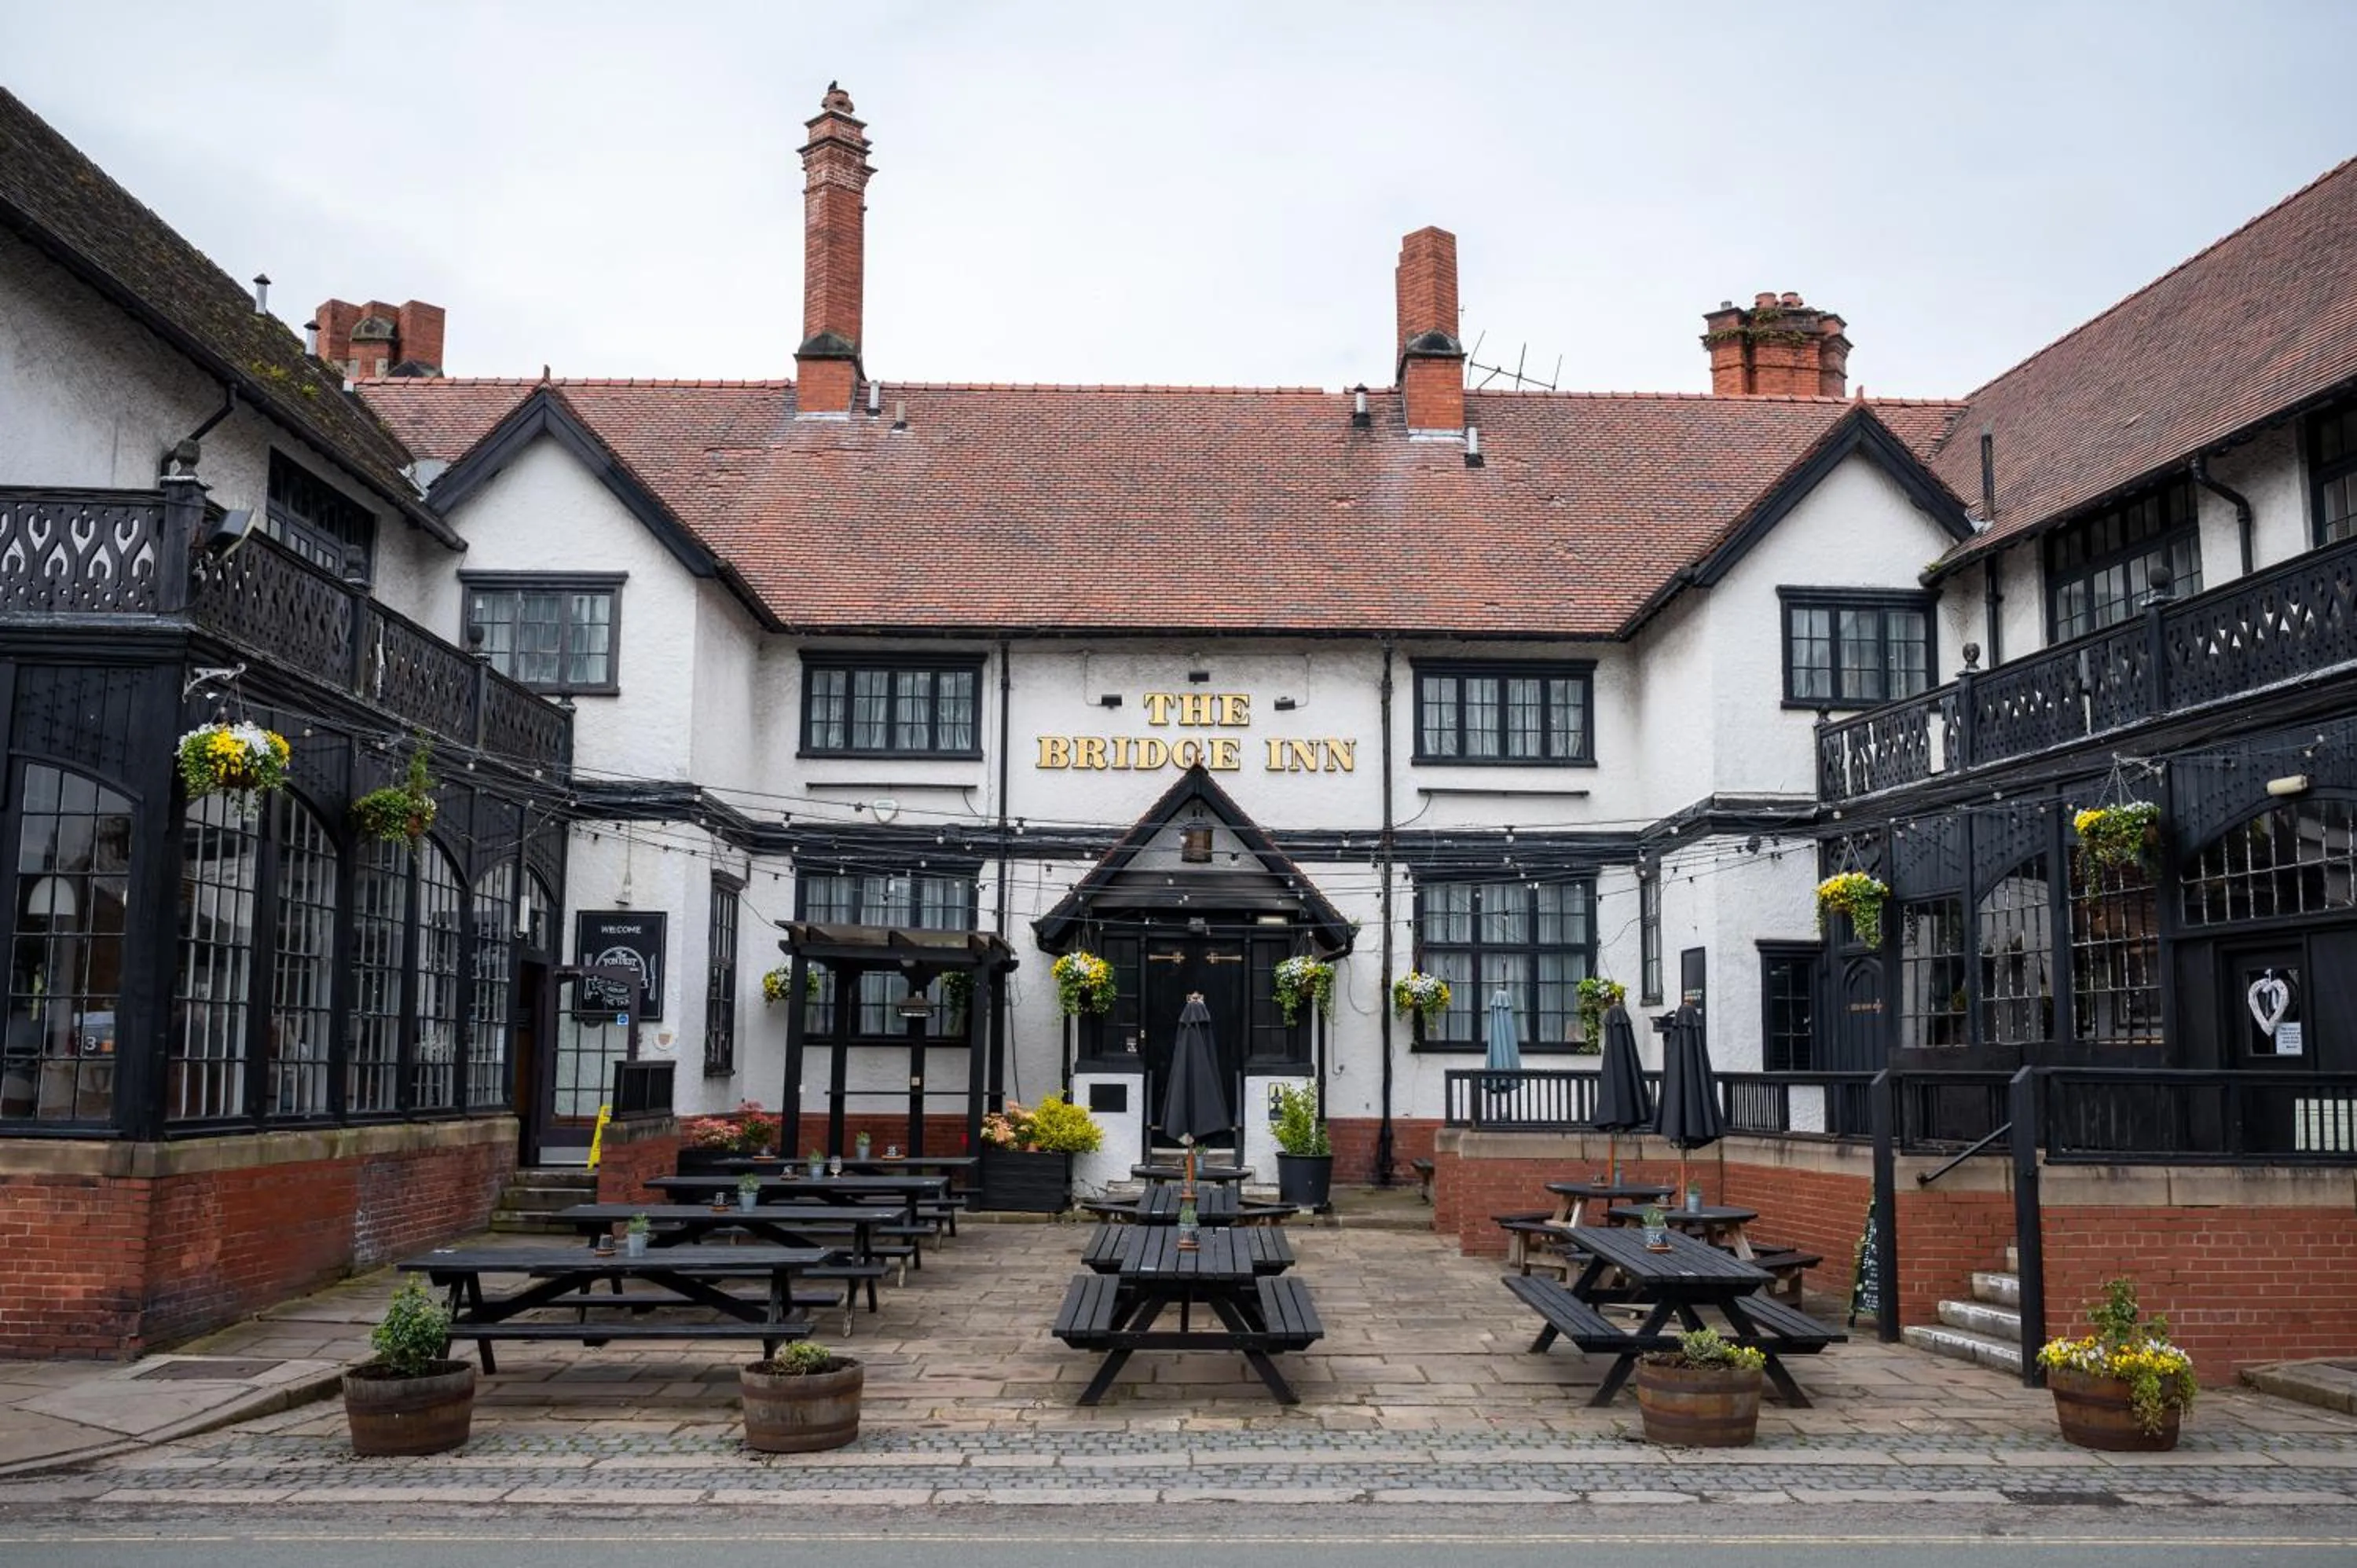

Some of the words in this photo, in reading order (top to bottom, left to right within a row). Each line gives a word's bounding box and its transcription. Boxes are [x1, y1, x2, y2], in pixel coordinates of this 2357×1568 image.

[1143, 692, 1251, 726] THE
[1036, 735, 1241, 771] BRIDGE
[1265, 737, 1357, 771] INN
[601, 925, 641, 934] WELCOME
